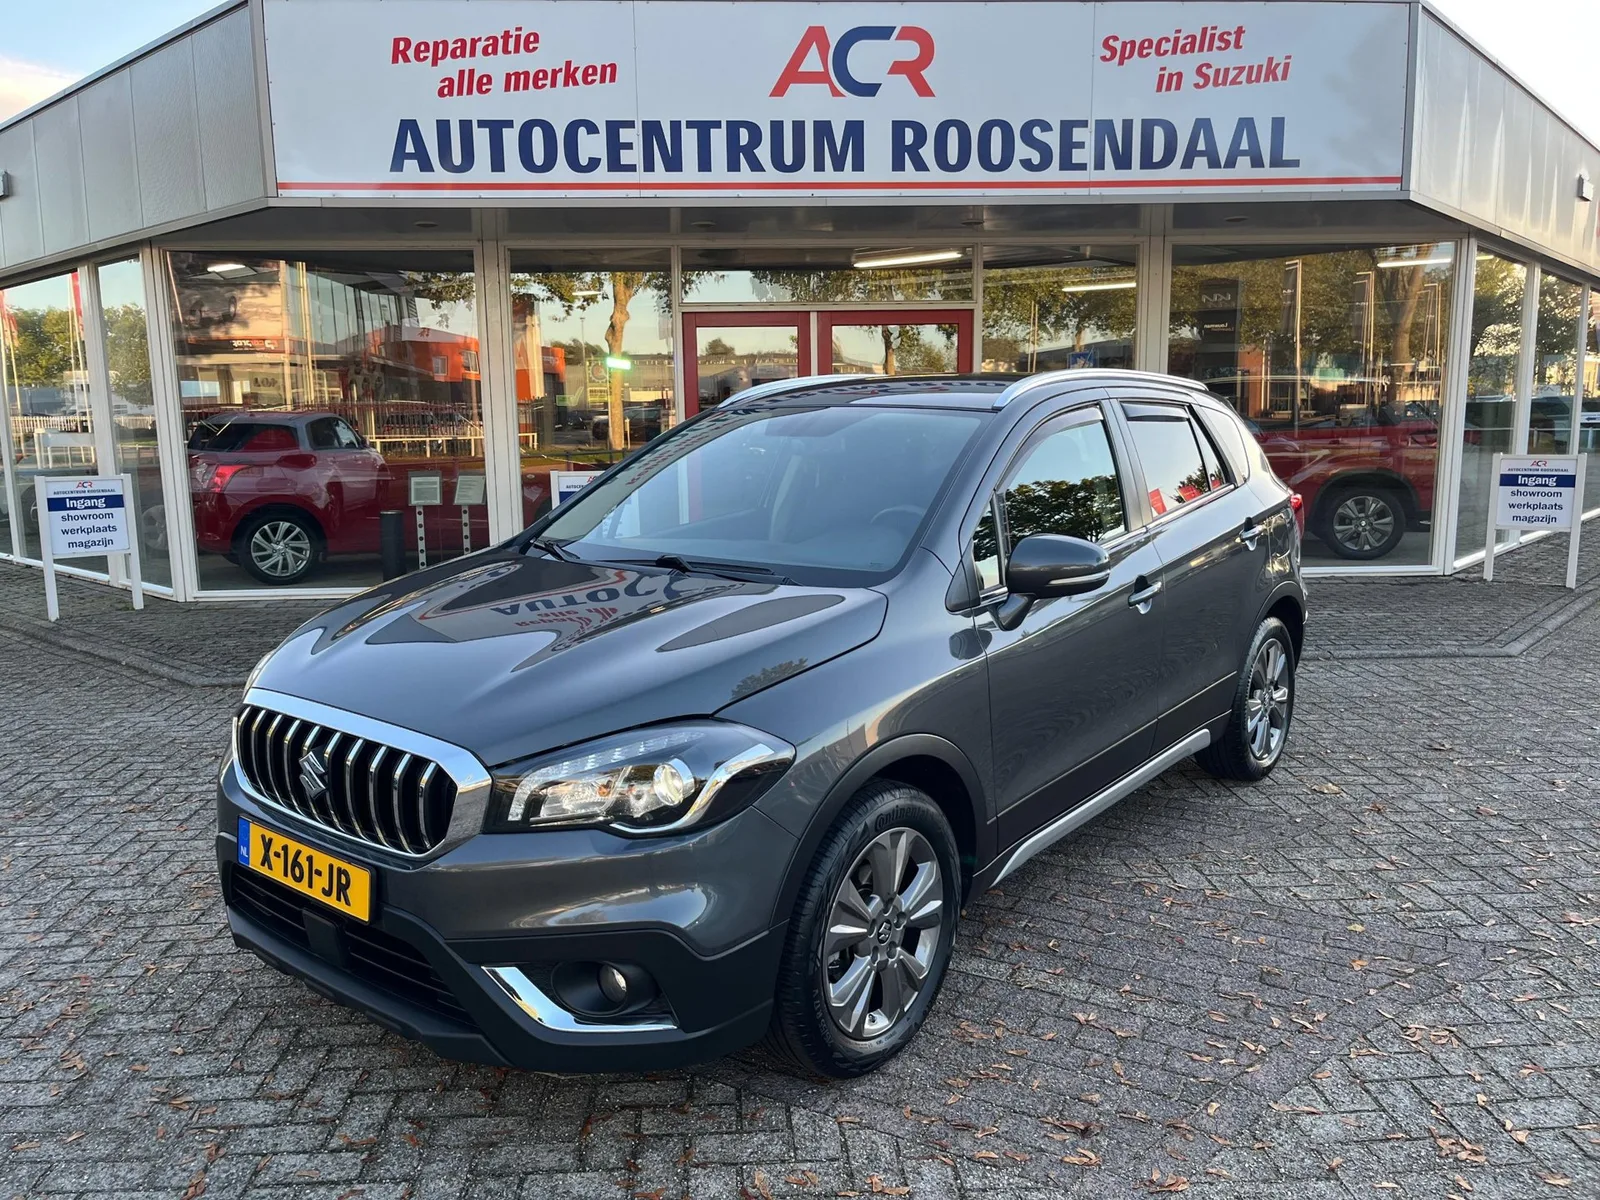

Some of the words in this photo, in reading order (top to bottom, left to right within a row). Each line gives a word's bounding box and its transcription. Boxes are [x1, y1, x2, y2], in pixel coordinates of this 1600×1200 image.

[391, 26, 540, 67] Reparatie
[1099, 24, 1246, 67] Specialist
[768, 25, 937, 98] ACR
[437, 68, 493, 99] alle
[503, 60, 618, 93] merken
[1155, 66, 1184, 94] in
[1193, 55, 1292, 91] Suzuki
[389, 118, 866, 174] AUTOCENTRUM
[890, 116, 1301, 173] ROOSENDAAL
[75, 481, 93, 489] ACR
[1517, 475, 1558, 487] Ingang
[1510, 488, 1563, 498] showroom
[65, 497, 106, 510] Ingang
[1508, 501, 1563, 512] werkplaats
[60, 512, 114, 522] showroom
[1512, 514, 1557, 525] magazijn
[60, 524, 118, 536] werkplaats
[67, 537, 114, 549] magazijn
[240, 845, 249, 858] NL
[260, 833, 352, 907] X-161-JR
